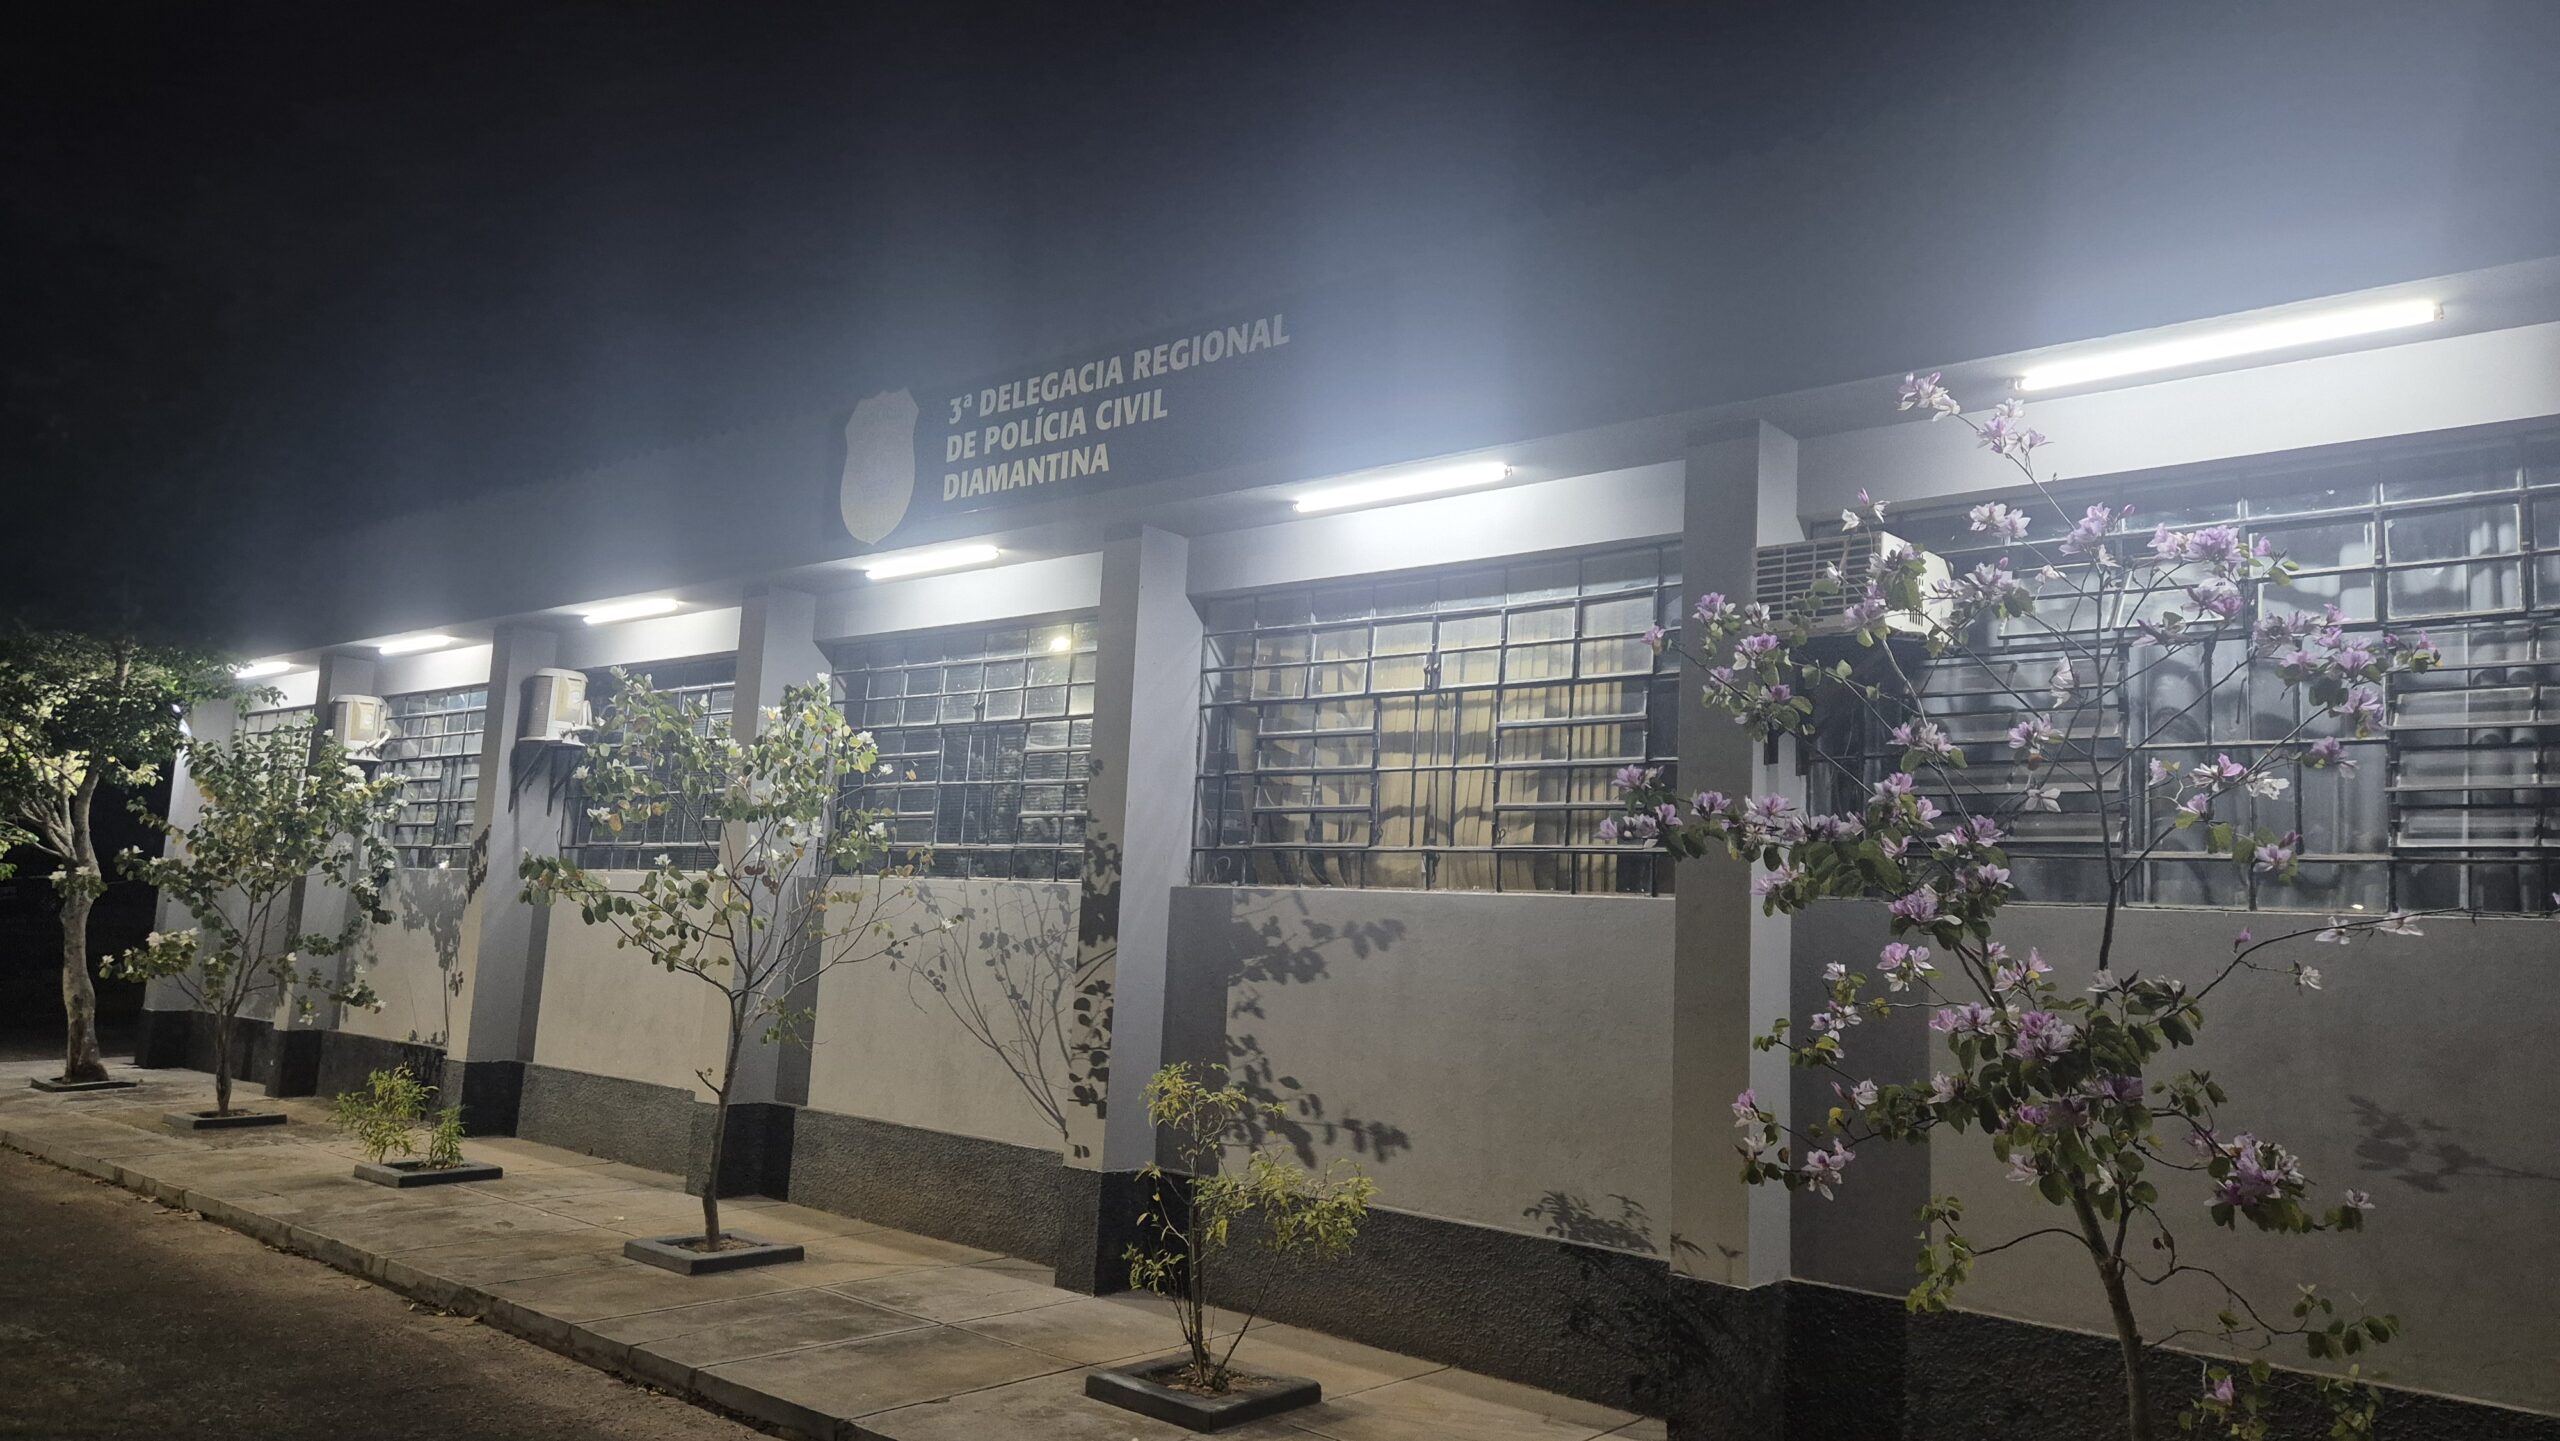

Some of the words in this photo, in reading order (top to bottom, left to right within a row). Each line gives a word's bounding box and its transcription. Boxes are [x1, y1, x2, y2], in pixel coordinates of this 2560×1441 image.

[949, 393, 973, 425] 3ª
[979, 355, 1124, 417] DELEGACIA
[1133, 313, 1291, 381] REGIONAL
[945, 431, 977, 463] DE
[983, 407, 1087, 455] POLÍCIA
[1095, 388, 1169, 431] CIVIL
[943, 443, 1110, 502] DIAMANTINA
